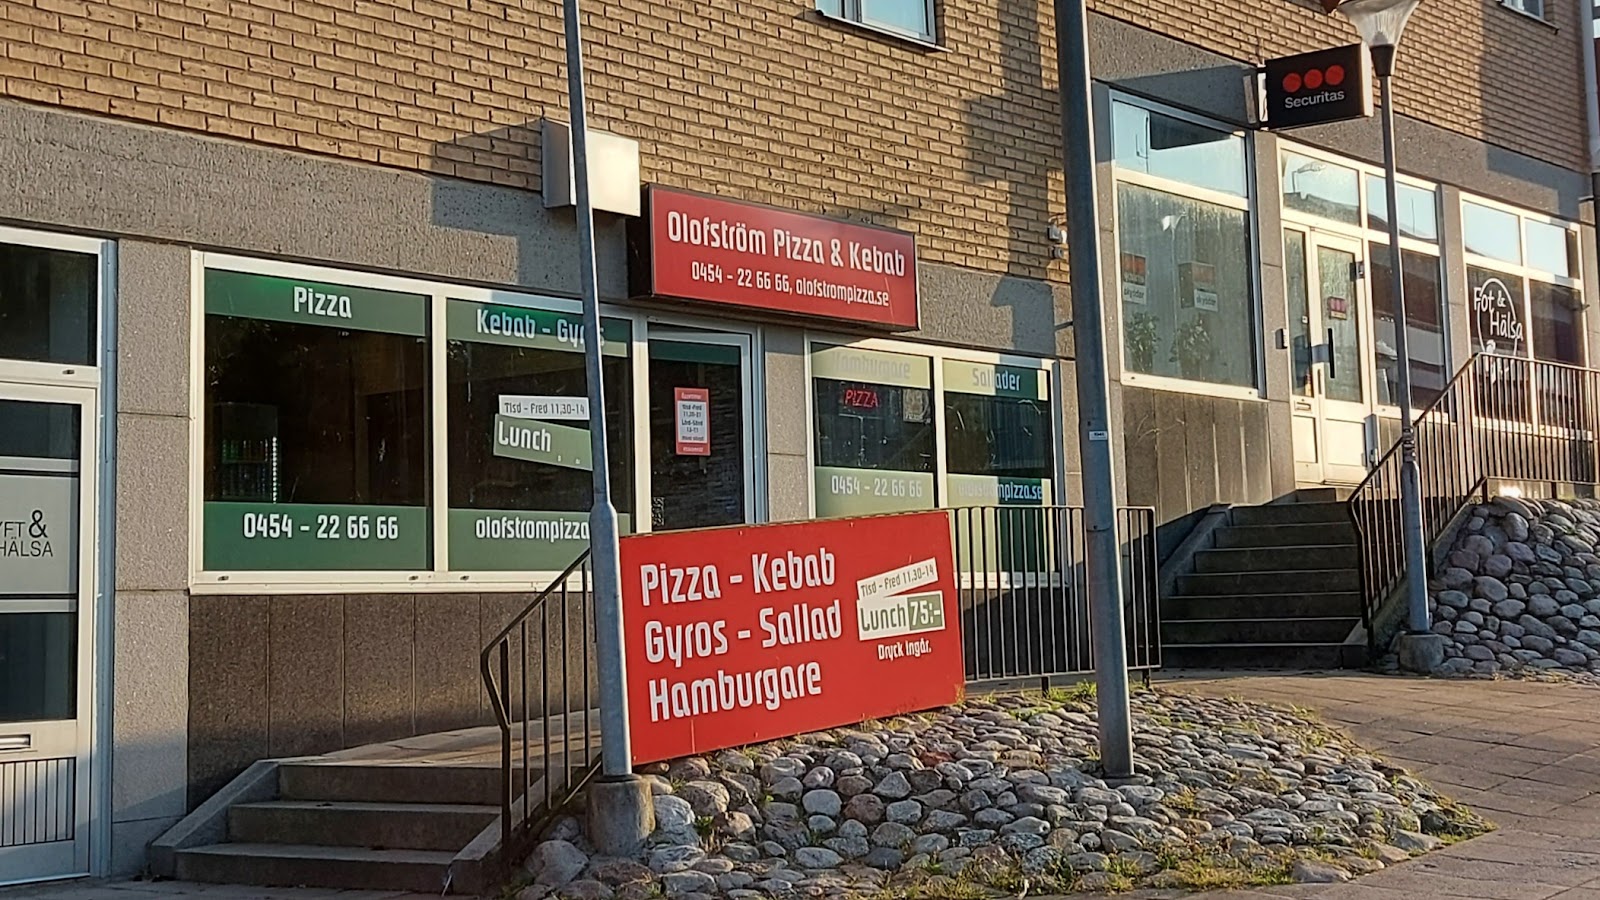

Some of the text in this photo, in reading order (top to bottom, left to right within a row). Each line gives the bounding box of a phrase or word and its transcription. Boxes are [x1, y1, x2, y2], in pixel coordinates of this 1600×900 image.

[1284, 90, 1345, 109] Securitas
[667, 211, 905, 277] Olofström Pizza & Kebab
[691, 260, 723, 283] 0454
[737, 267, 753, 288] 22
[756, 271, 771, 290] 66
[775, 273, 793, 295] 66,
[796, 278, 889, 307] olofstrompizza.se
[293, 287, 352, 319] Pizza
[1474, 286, 1507, 313] Fot &
[476, 309, 535, 339] Kebab
[556, 318, 605, 348] Gyrs
[1489, 309, 1524, 342] Hälsa
[972, 367, 1021, 392] Sallader
[504, 402, 522, 414] Tisd
[530, 404, 548, 415] Fred
[844, 388, 879, 408] PIZZA
[498, 420, 551, 452] Lunch
[831, 475, 860, 495] 0454
[874, 478, 888, 496] 22
[892, 479, 905, 497] 66
[909, 480, 922, 498] 66
[28, 509, 48, 538] &
[243, 513, 293, 539] 0454
[317, 515, 340, 540] 22
[347, 516, 369, 540] 66
[376, 516, 398, 540] 66
[640, 563, 721, 606] Pizza
[751, 547, 835, 594] Kebab
[861, 580, 877, 597] Tisd
[885, 573, 900, 590] Fred
[860, 600, 941, 631] Lunch 75:-
[644, 620, 728, 668] Gyros
[759, 600, 842, 648] Sallad
[878, 642, 904, 661] Dryck
[649, 662, 822, 722] Hamburgare
